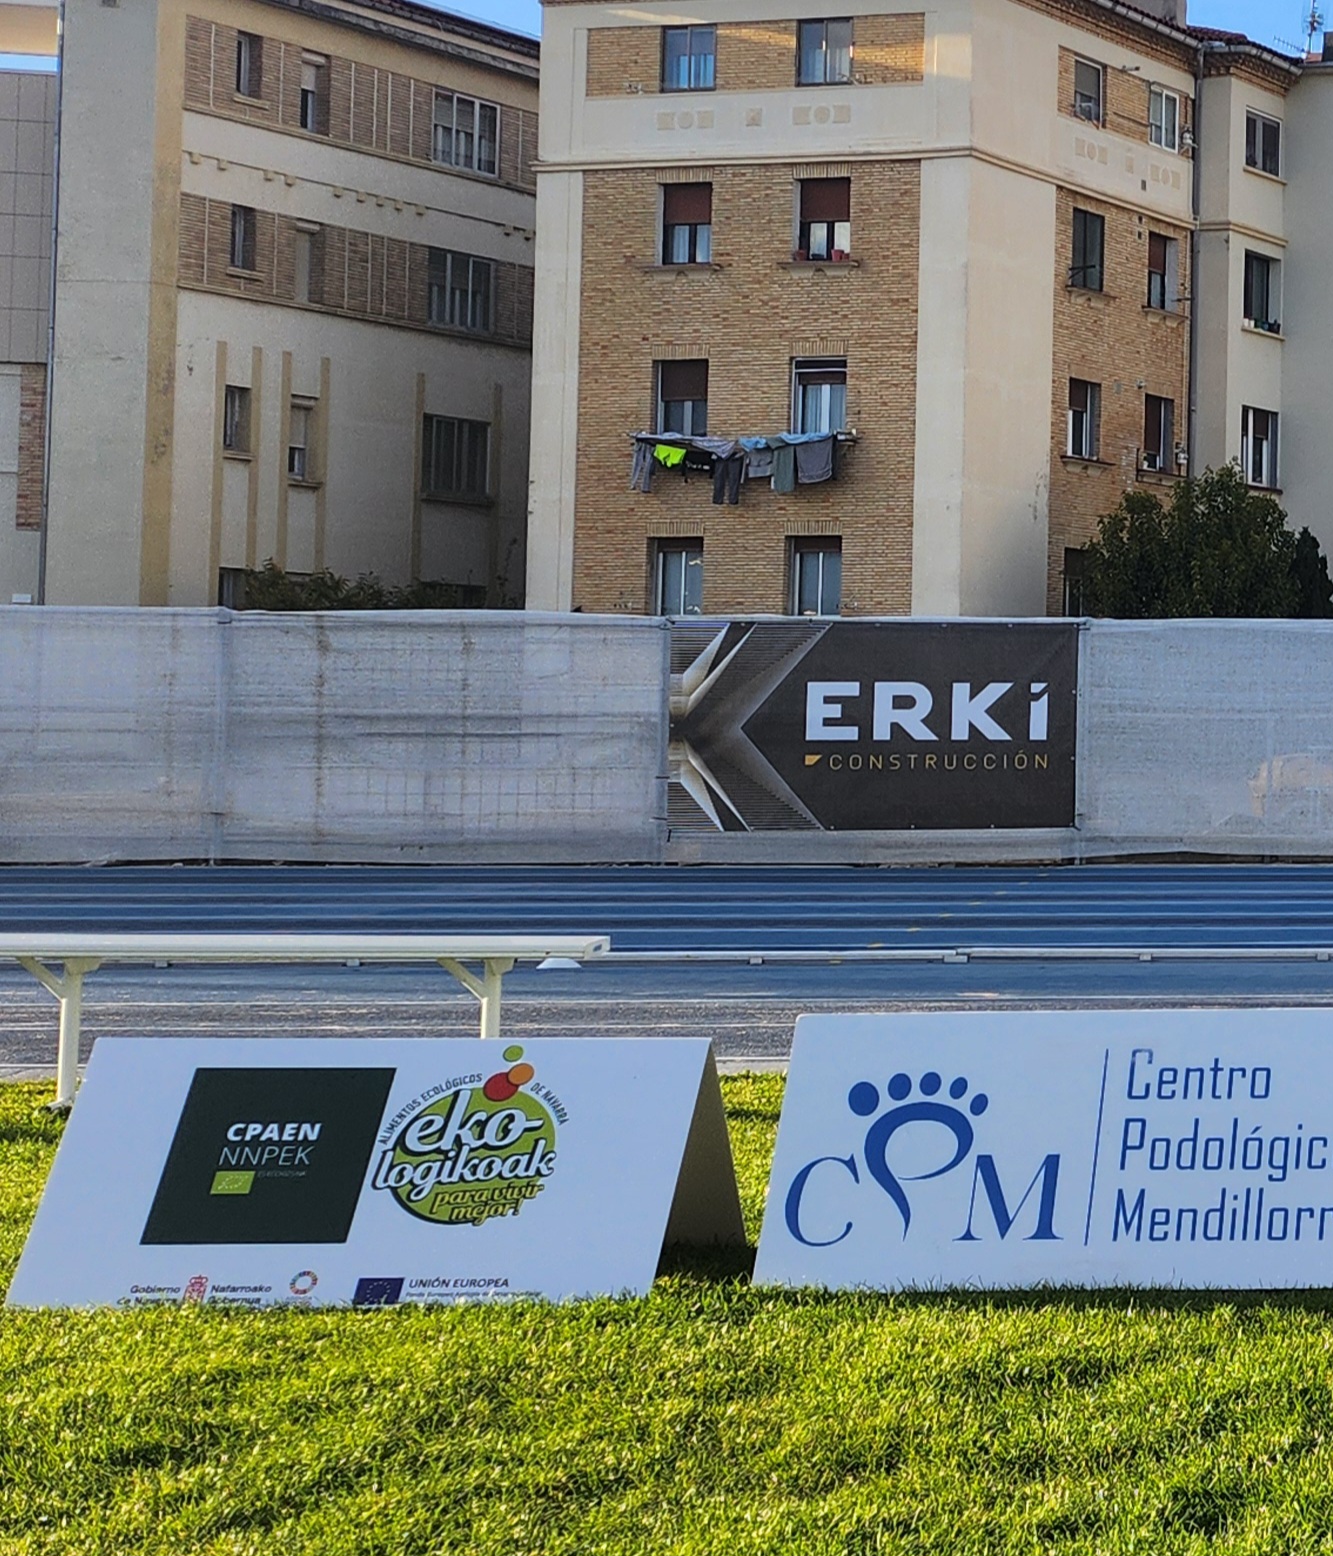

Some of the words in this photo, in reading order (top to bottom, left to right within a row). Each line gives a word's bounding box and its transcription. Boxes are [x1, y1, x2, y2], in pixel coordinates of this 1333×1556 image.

[829, 750, 1048, 770] CONSTRUCCIÓN
[1127, 1048, 1272, 1101] Centro
[378, 1099, 421, 1145] ALIMENTOS
[421, 1073, 483, 1103] ECOLÓGICOS
[530, 1082, 545, 1096] DE
[542, 1088, 570, 1126] NAVARRA
[226, 1122, 322, 1141] CPAEN
[218, 1145, 315, 1166] NNPEK
[372, 1138, 557, 1203] logikoak
[430, 1187, 492, 1215] para
[493, 1181, 545, 1199] vivir
[449, 1198, 524, 1226] mejor!
[130, 1284, 181, 1294] Gobierno
[211, 1284, 272, 1294] Nafarroako
[409, 1277, 450, 1289] UNIÓN
[452, 1277, 510, 1289] EUROPEA
